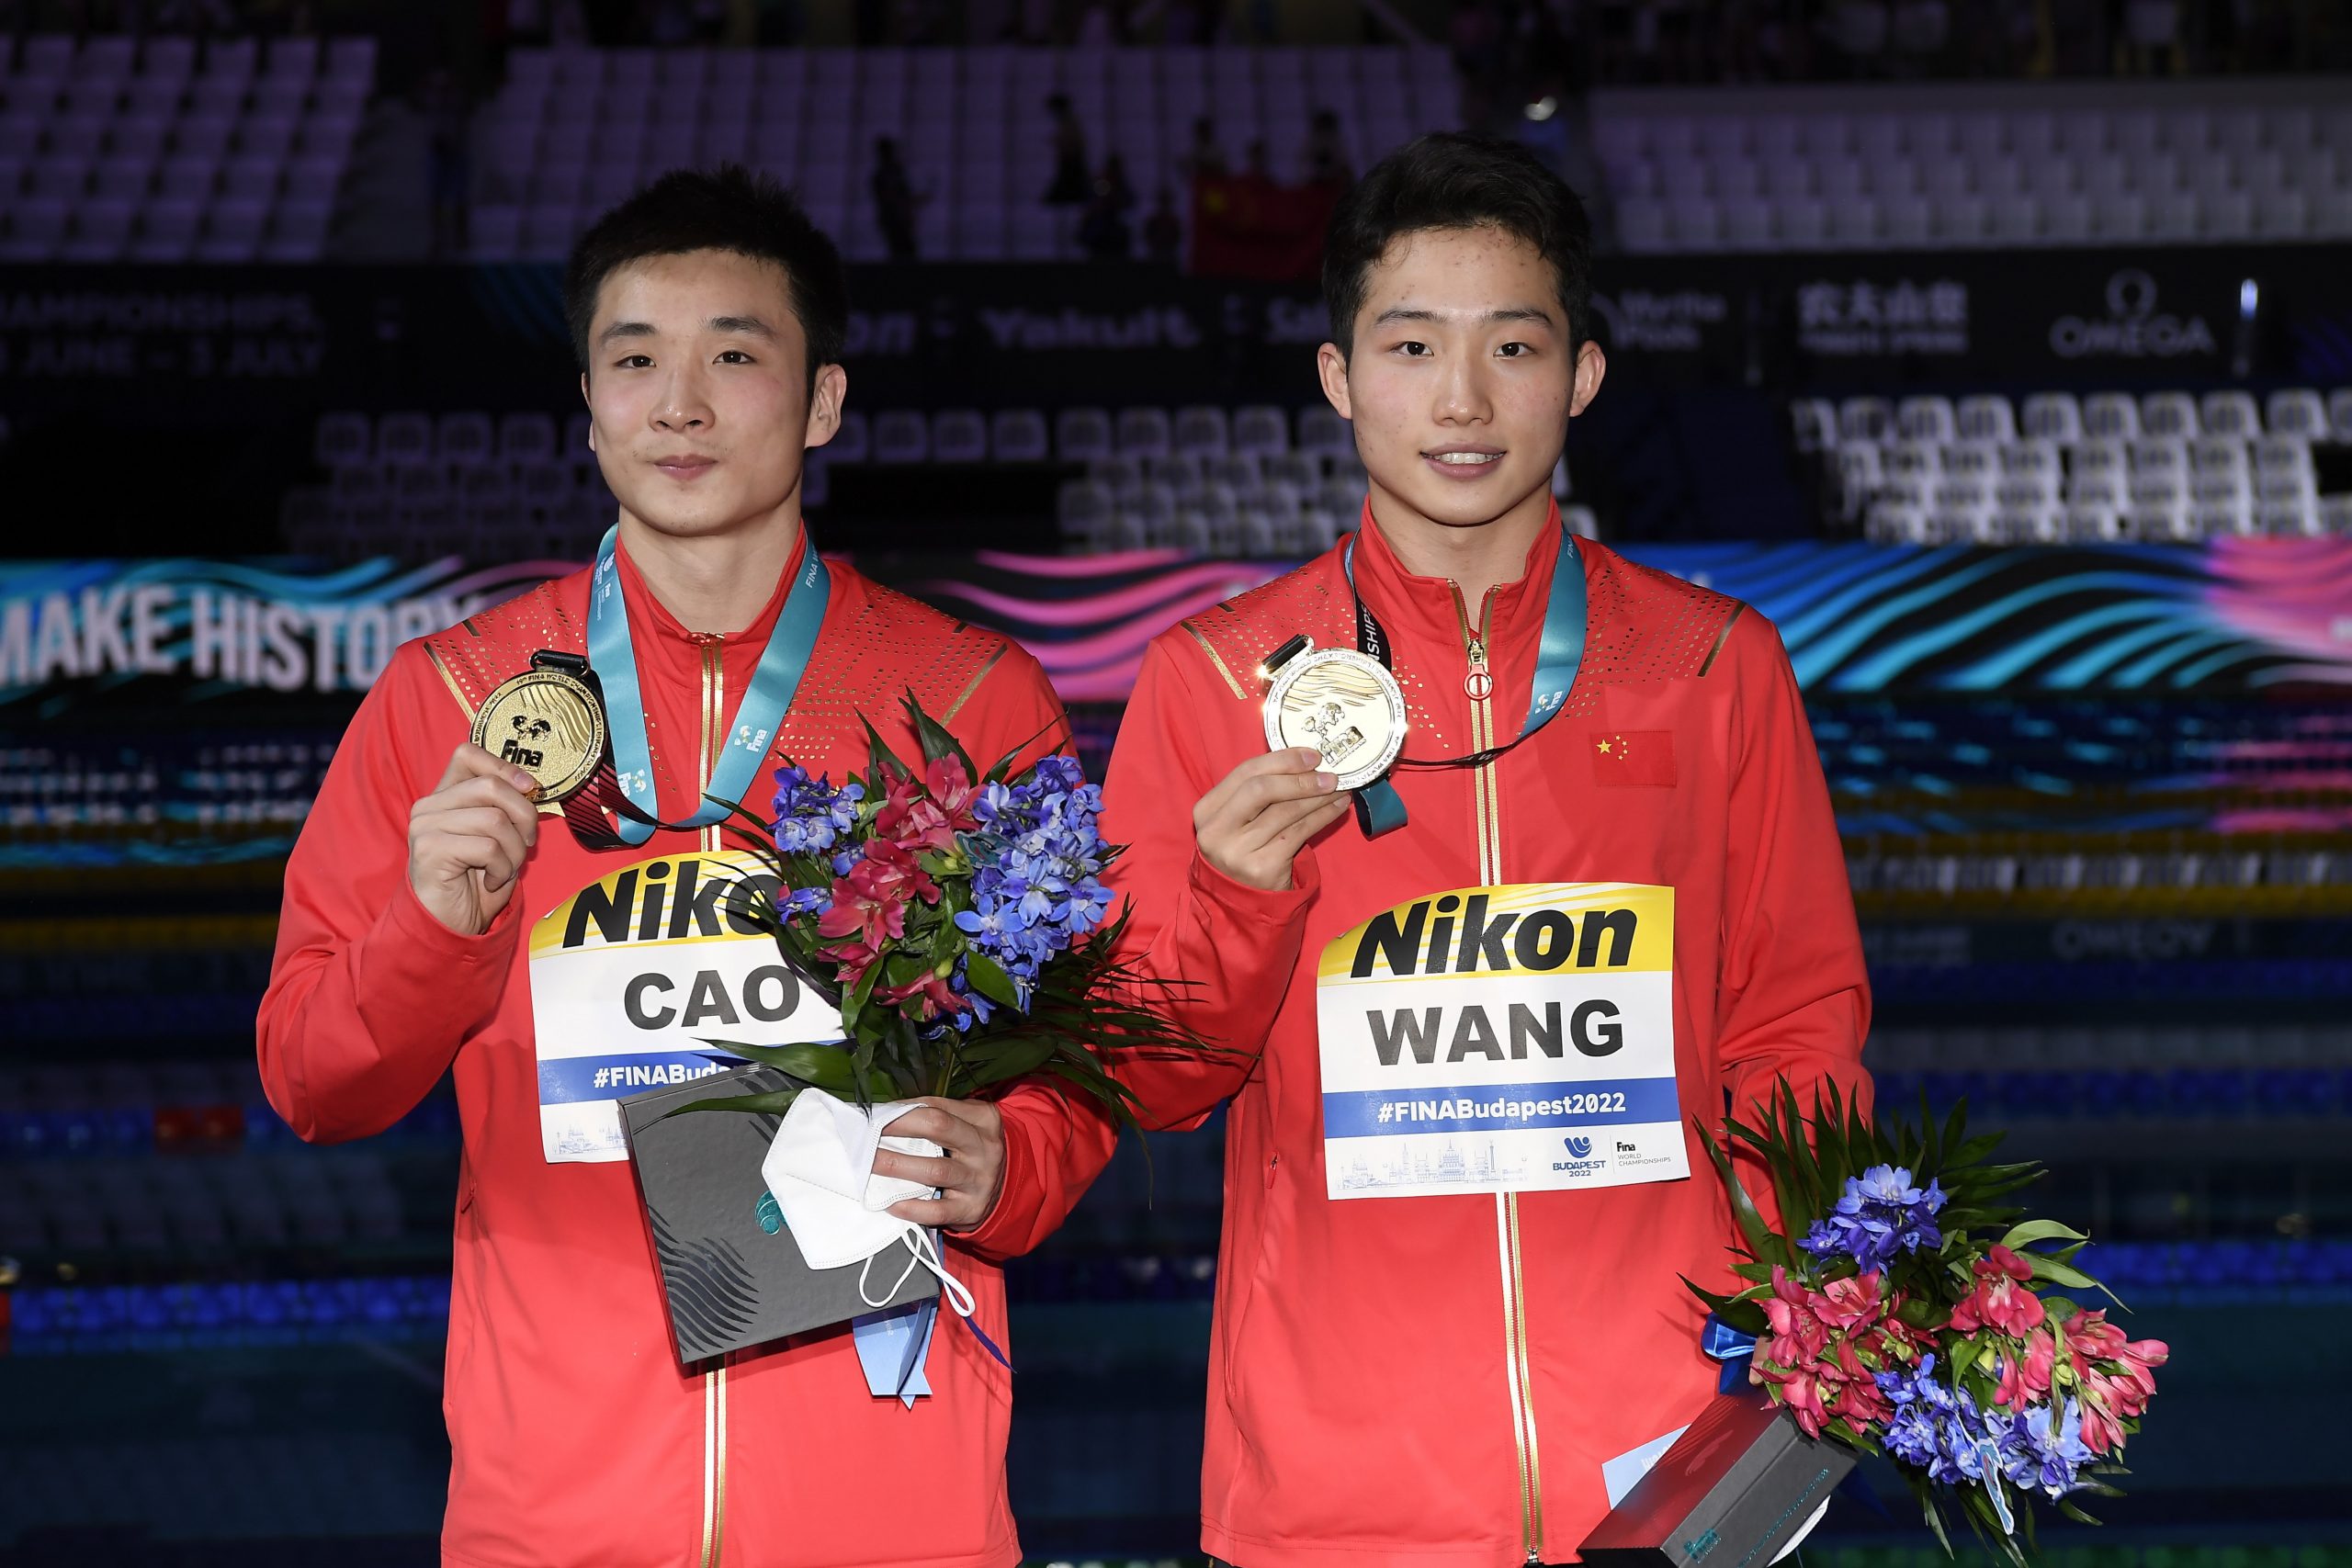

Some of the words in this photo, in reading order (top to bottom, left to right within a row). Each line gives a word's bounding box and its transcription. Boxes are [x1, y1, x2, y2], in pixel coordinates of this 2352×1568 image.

[974, 306, 1204, 348] Yakult
[2048, 313, 2218, 359] OMEGA
[806, 563, 818, 589] FINA
[0, 581, 176, 685] MAKE
[562, 860, 784, 948] Niko
[1351, 894, 1637, 978] Nikon
[624, 965, 800, 1030] CAO
[1365, 998, 1623, 1066] WANG
[594, 1062, 731, 1088] #FINABud
[1377, 1092, 1626, 1123] #FINABudapest2022
[1553, 1160, 1607, 1171] BUDAPEST
[1616, 1142, 1636, 1152] Fina
[1619, 1156, 1671, 1167] CHAMPIONSHIPS
